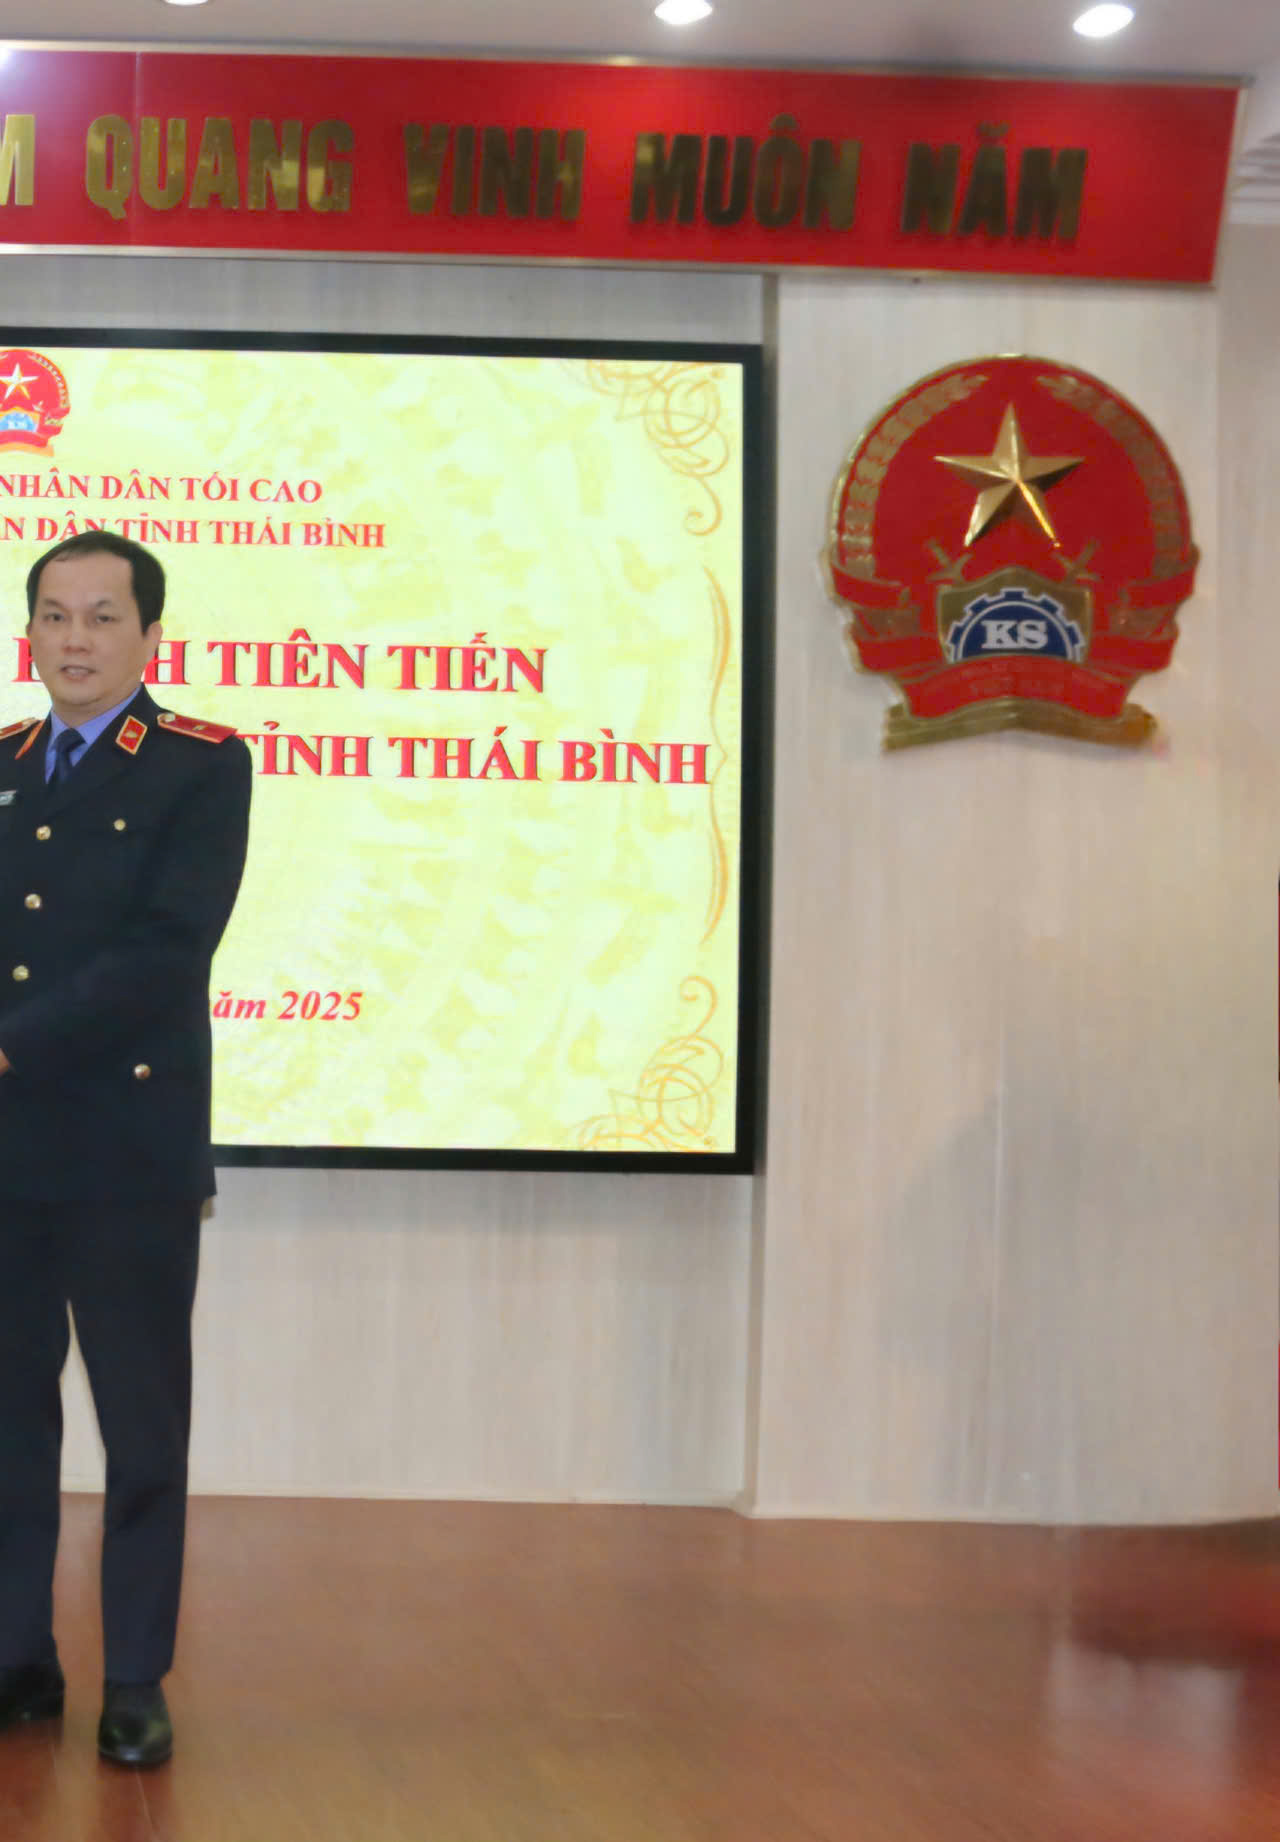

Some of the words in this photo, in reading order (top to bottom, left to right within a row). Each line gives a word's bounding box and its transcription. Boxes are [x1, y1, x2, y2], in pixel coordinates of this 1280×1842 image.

[86, 113, 355, 220] QUANG
[403, 122, 587, 221] VINH
[627, 113, 863, 232] MUÔN
[900, 121, 1090, 242] NĂM
[100, 468, 171, 500] DÂN
[179, 471, 240, 502] TỐI
[249, 478, 323, 503] CAO
[208, 516, 291, 546] THÁI
[302, 517, 386, 548] BÌNH
[981, 619, 1050, 650] KS
[205, 628, 367, 690] TIÊN
[386, 631, 548, 694] TIẾN
[236, 720, 374, 777] ỈNH
[387, 726, 542, 781] THÁI
[557, 728, 710, 785] BÌNH
[211, 989, 268, 1019] ăm
[277, 990, 364, 1021] 2025
